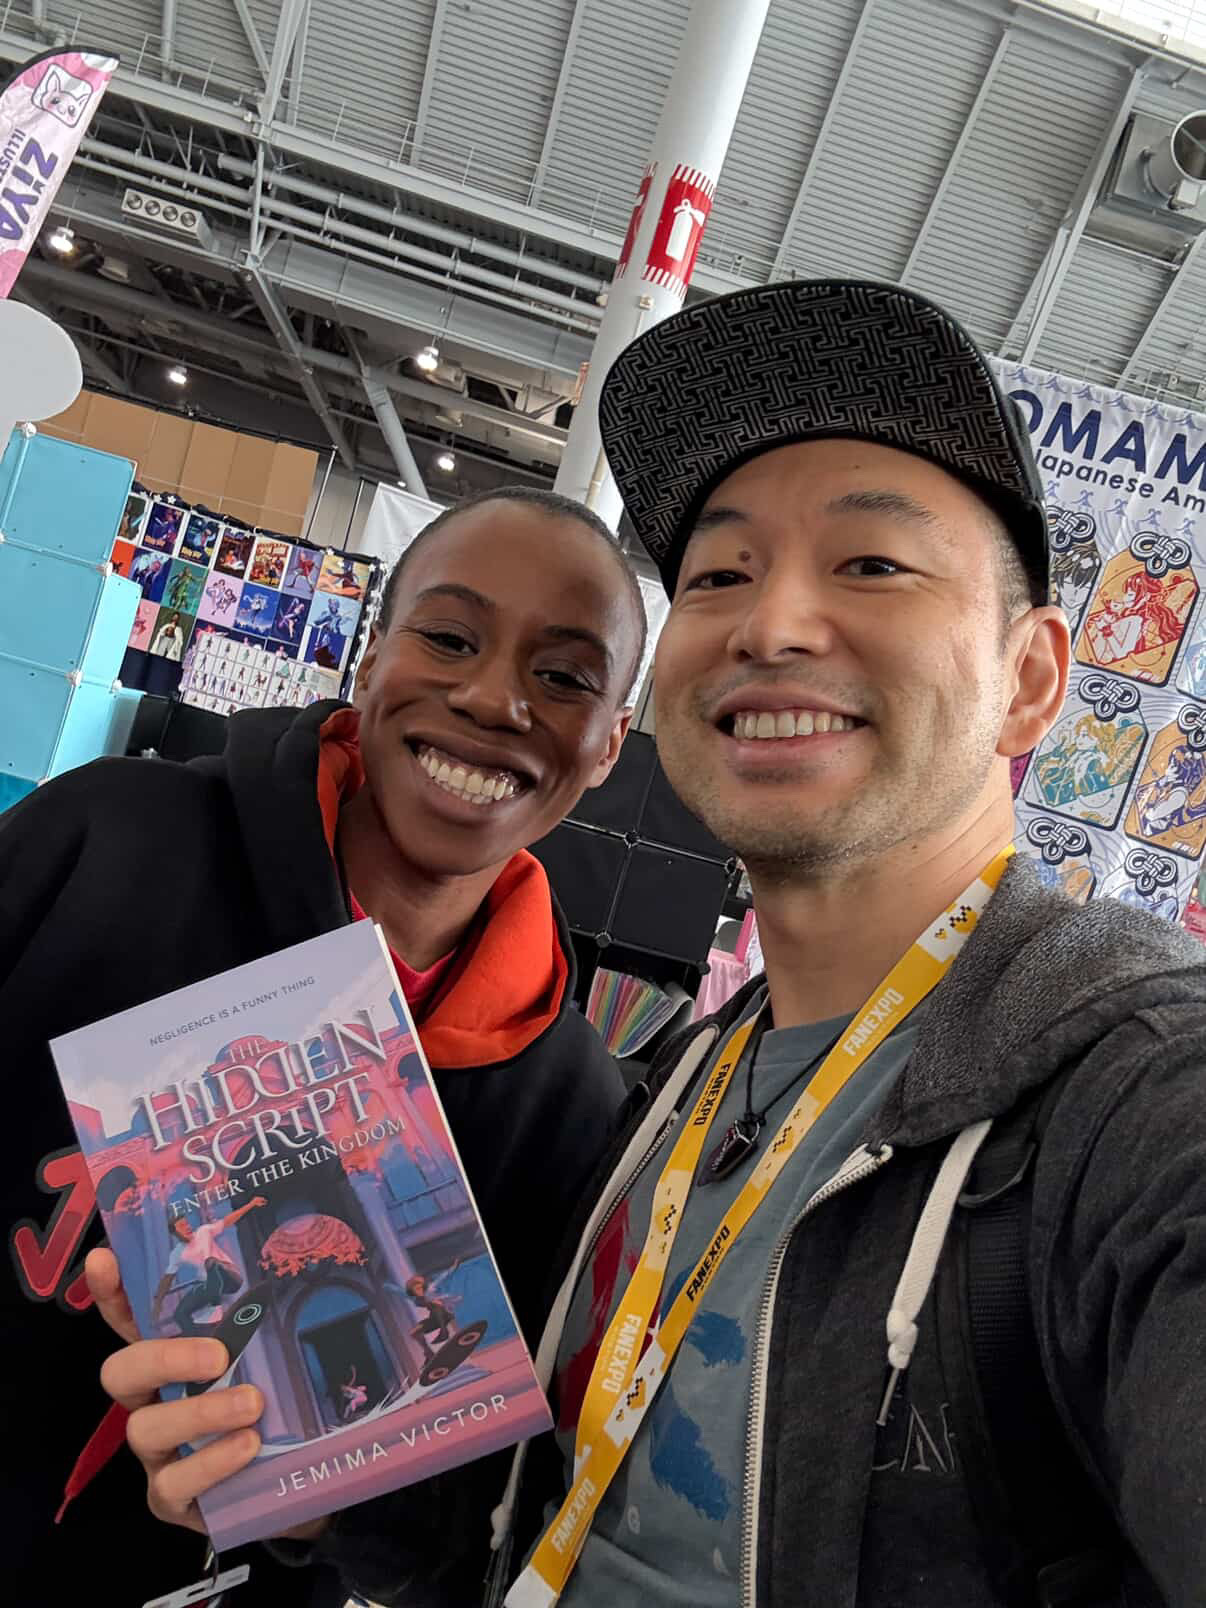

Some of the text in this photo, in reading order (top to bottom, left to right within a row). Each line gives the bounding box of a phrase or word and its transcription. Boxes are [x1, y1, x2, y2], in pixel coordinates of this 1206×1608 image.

[149, 975, 316, 1047] NEGLIGENCE IS A FUNNY THING
[229, 1038, 269, 1063] THE
[140, 1006, 388, 1151] HIDDEN
[182, 1071, 371, 1184] SCRIPT
[170, 1114, 406, 1218] ENTER THE KINGDOM
[275, 1393, 508, 1498] JEMIMA VICTOR
